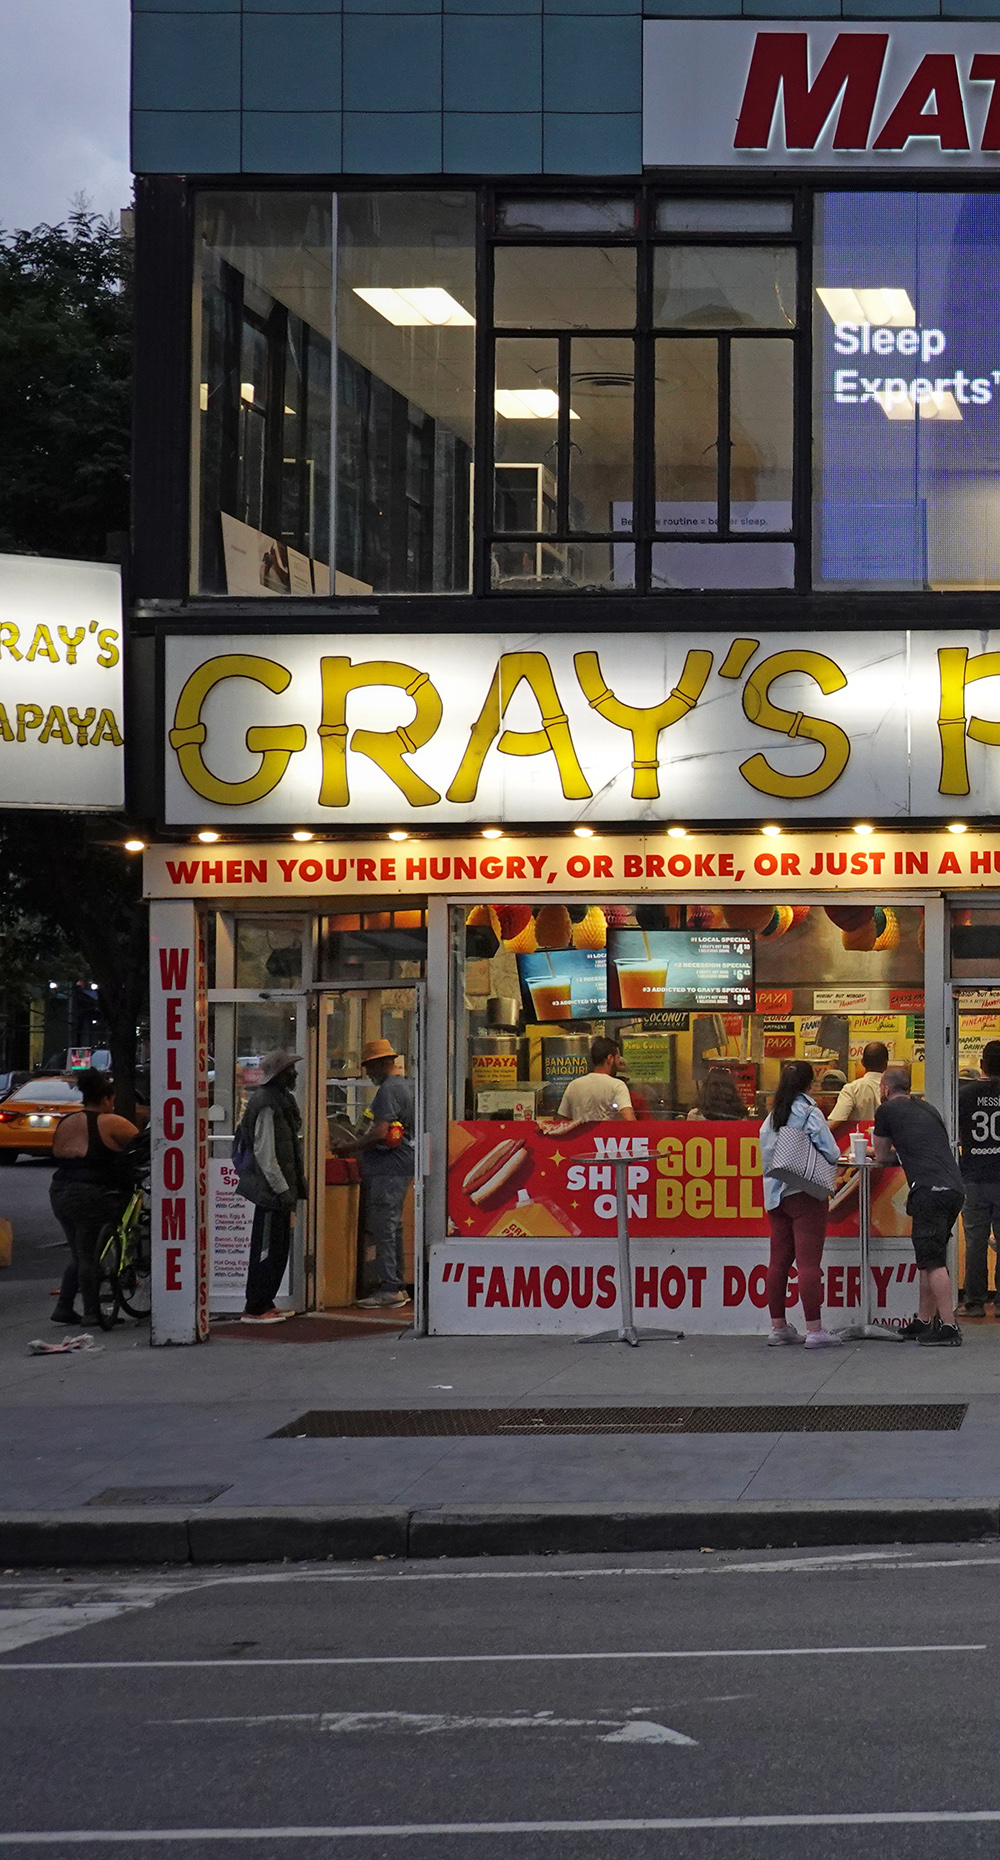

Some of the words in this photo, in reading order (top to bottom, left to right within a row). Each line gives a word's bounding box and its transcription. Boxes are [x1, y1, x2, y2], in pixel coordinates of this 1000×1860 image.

[834, 321, 947, 362] Sleep
[663, 517, 698, 526] routine
[708, 517, 738, 526] beer
[740, 517, 769, 528] sleep.
[168, 638, 851, 807] GRAY'S
[165, 860, 267, 884] WHEN
[276, 858, 396, 882] YOU'RE
[405, 855, 557, 884] HUNGRY,
[566, 855, 614, 879] OR
[624, 853, 745, 881] BROKE,
[753, 852, 800, 876] OR
[809, 851, 885, 875] JUST
[894, 851, 928, 875] IN
[937, 851, 962, 875] A
[473, 1057, 517, 1067] PAPAYA
[545, 1057, 588, 1066] BANANA
[546, 1066, 588, 1075] DAIQUIRI
[977, 1095, 1000, 1107] MESSI
[159, 948, 189, 1291] WELCOME
[594, 1137, 649, 1161] WE
[656, 1137, 763, 1177] GOLD
[566, 1165, 649, 1190] SHP
[594, 1194, 648, 1219] ON
[634, 1265, 707, 1309] HOT
[723, 1262, 918, 1309] DOGERY"
